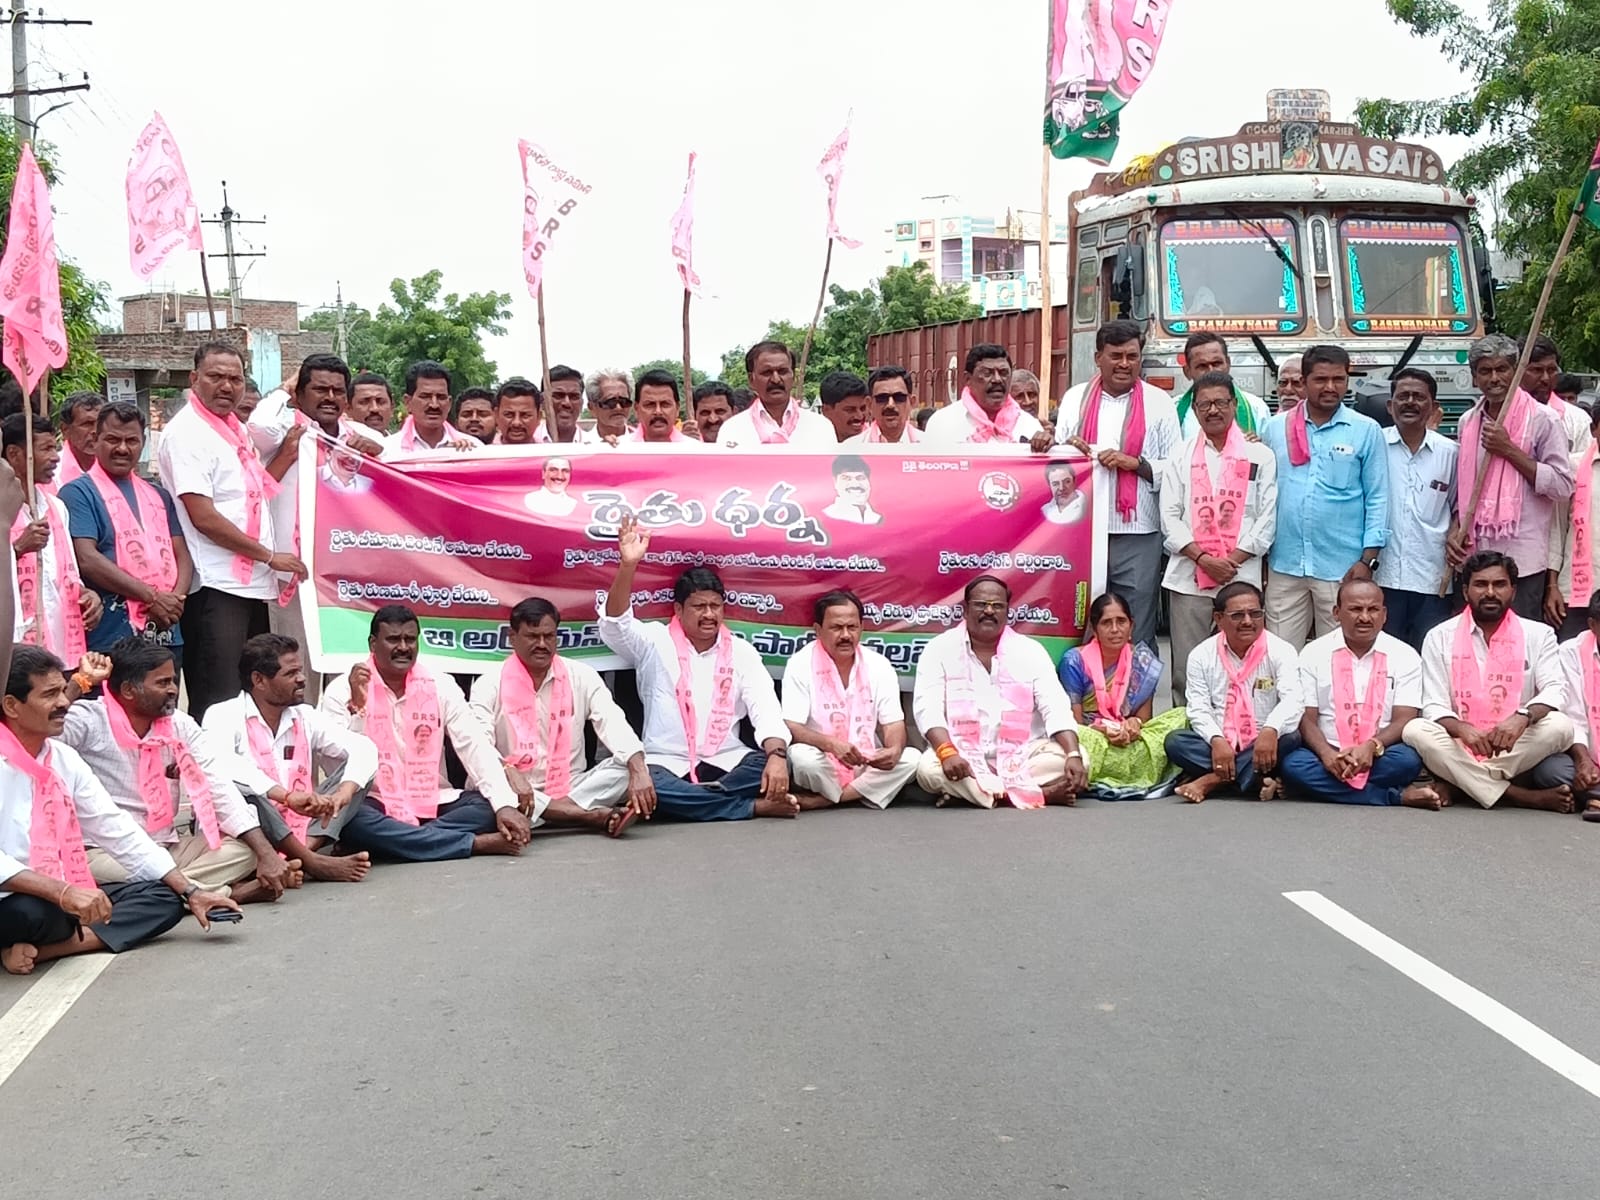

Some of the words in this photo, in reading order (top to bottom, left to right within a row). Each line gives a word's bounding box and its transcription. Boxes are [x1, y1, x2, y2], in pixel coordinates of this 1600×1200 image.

[583, 489, 705, 541] రైతు
[330, 529, 356, 551] రైతు
[445, 541, 482, 557] అమలు
[338, 580, 363, 601] రైతు
